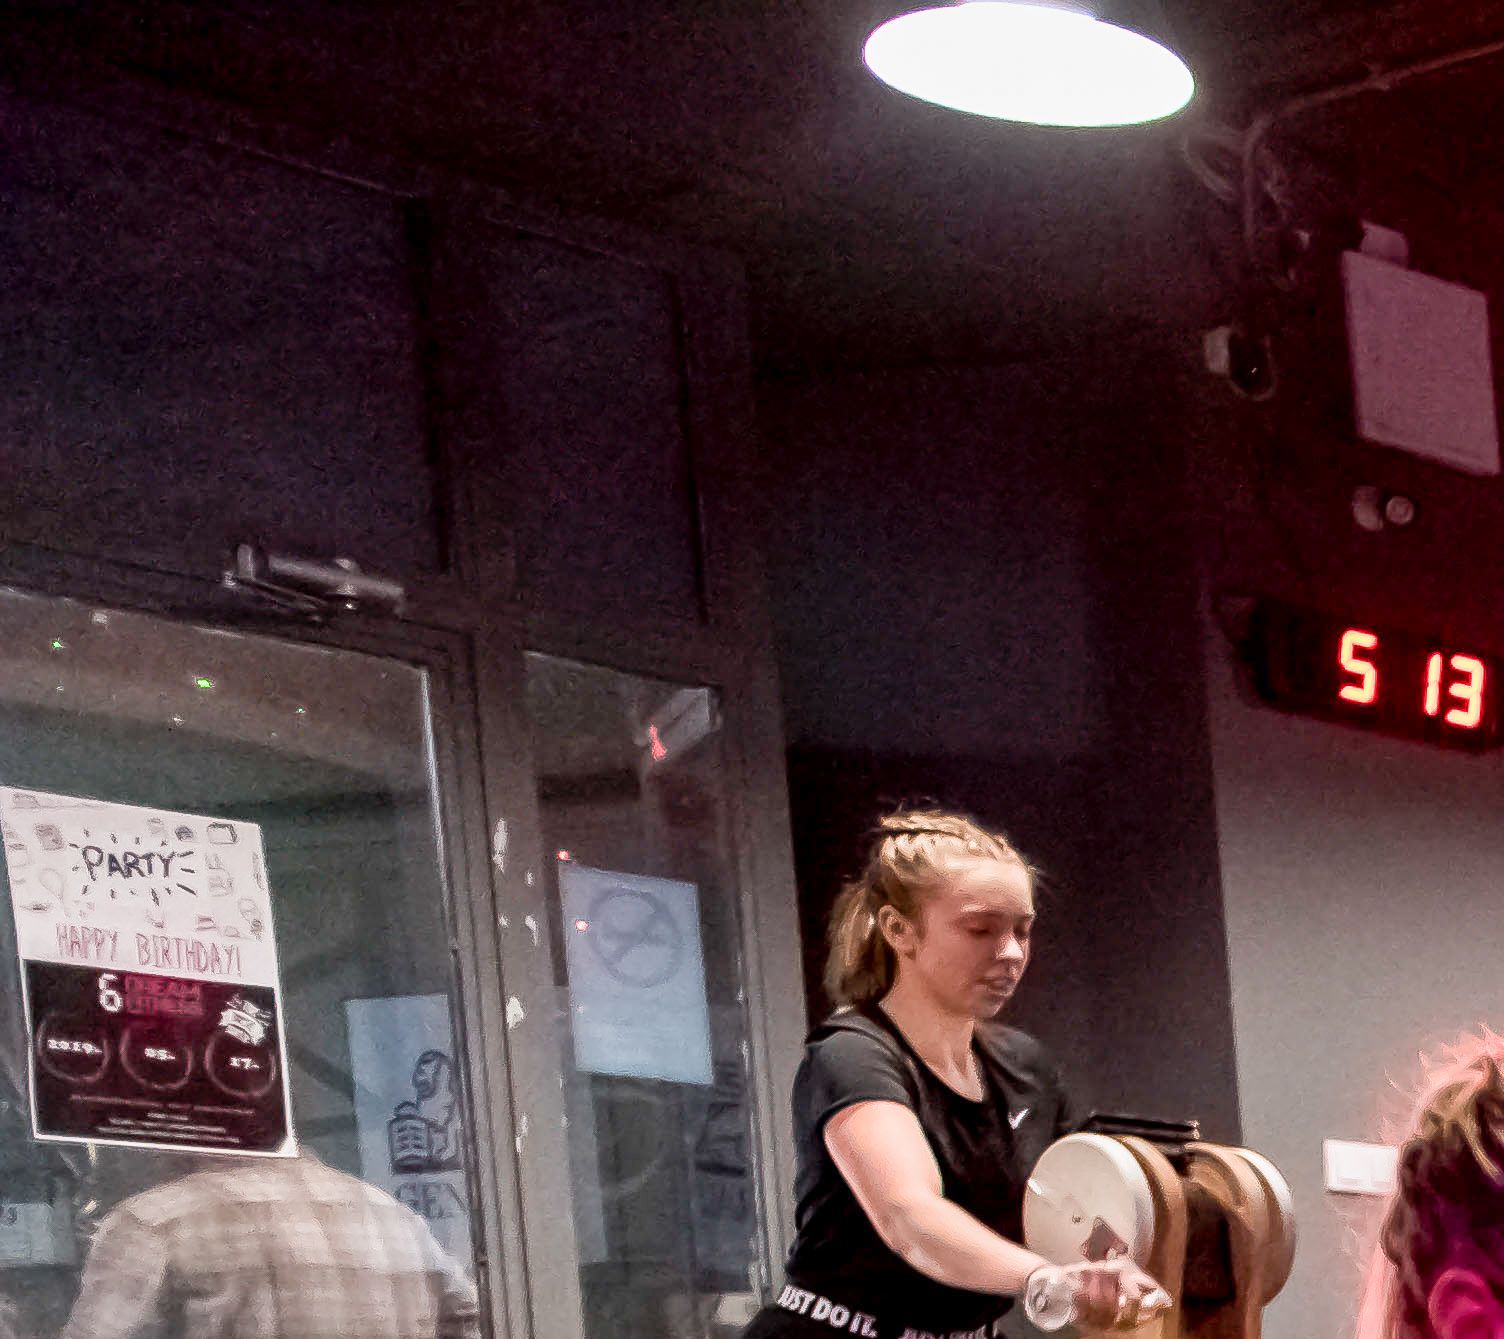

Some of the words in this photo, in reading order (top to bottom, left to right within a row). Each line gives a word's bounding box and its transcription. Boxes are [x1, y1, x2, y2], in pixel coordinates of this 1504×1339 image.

[1339, 629, 1377, 704] 5
[1424, 652, 1484, 728] 13
[82, 845, 177, 881] PARTY
[55, 923, 119, 962] HAPPY
[136, 933, 242, 976] BIRTHDAY!
[99, 972, 123, 1013] 6
[811, 1295, 850, 1329] DO
